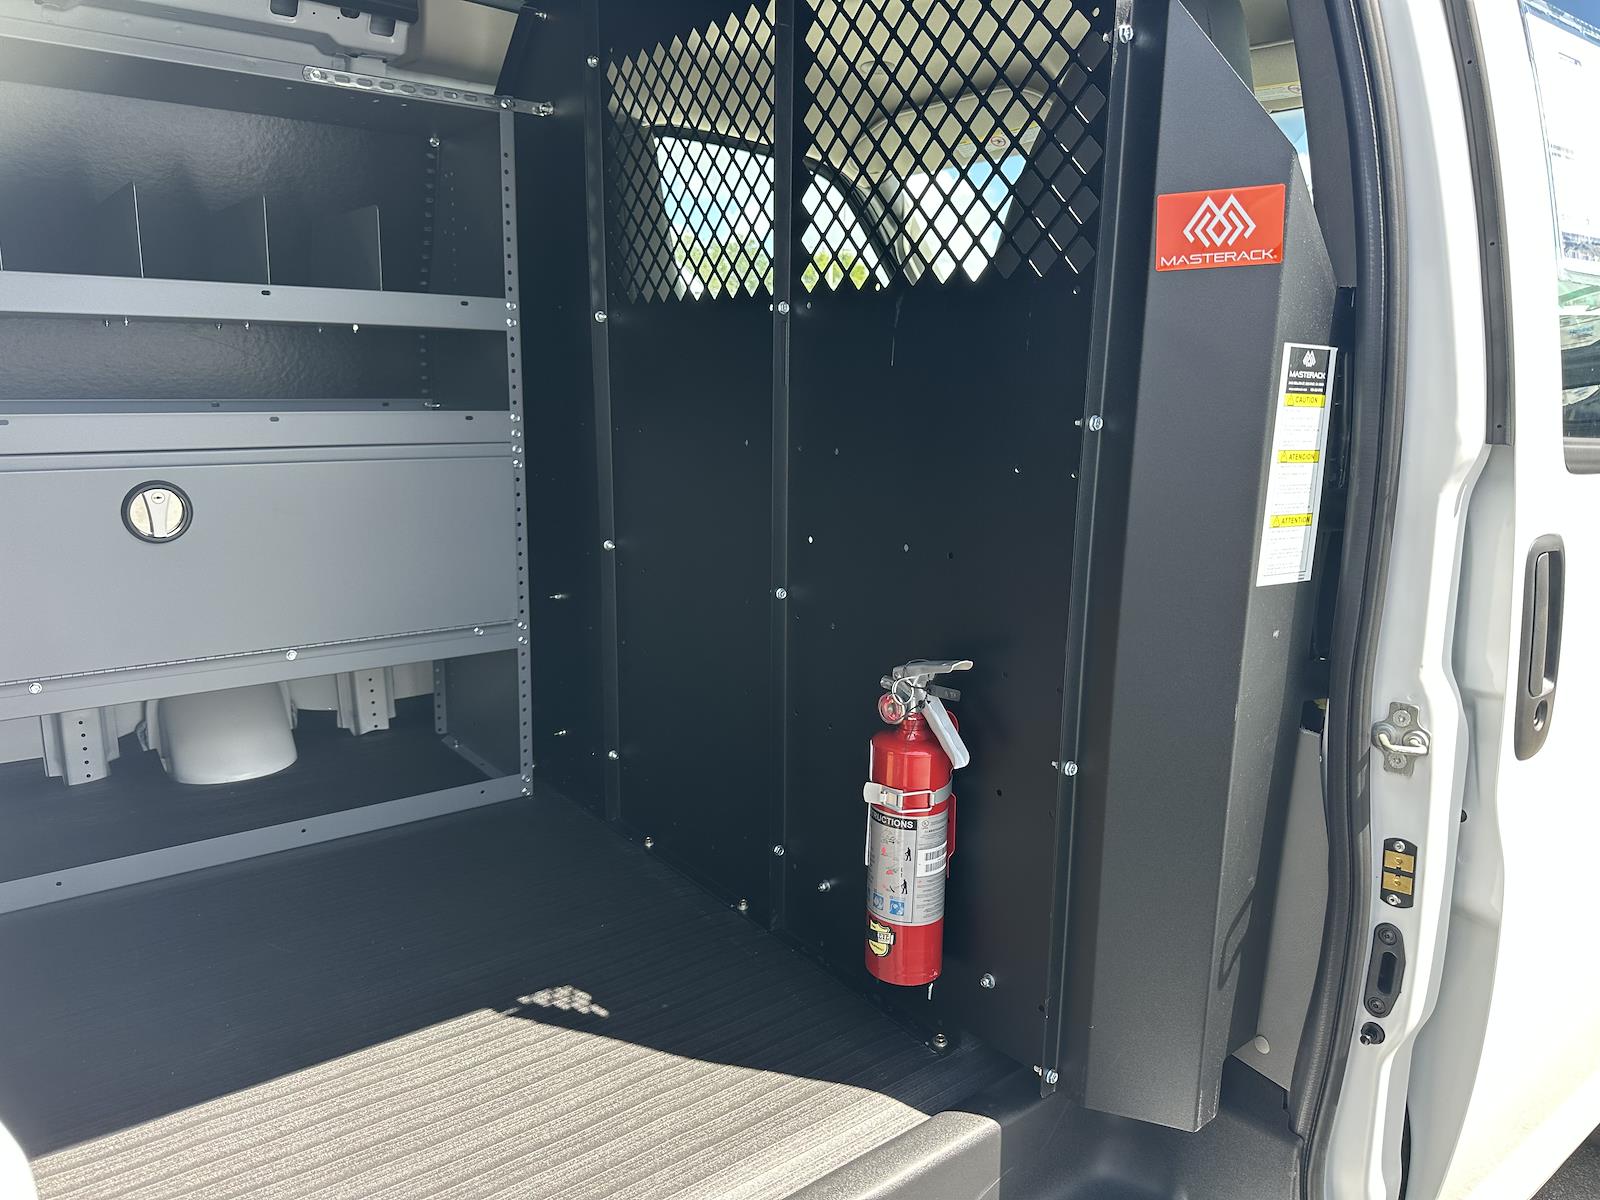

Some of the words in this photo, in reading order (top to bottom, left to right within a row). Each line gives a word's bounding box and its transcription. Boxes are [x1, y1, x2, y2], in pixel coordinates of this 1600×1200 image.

[1160, 249, 1275, 267] MASTERACK
[1289, 370, 1326, 379] MASTERACK
[1295, 395, 1318, 404] CAUTION
[1281, 515, 1311, 524] ATTENTION
